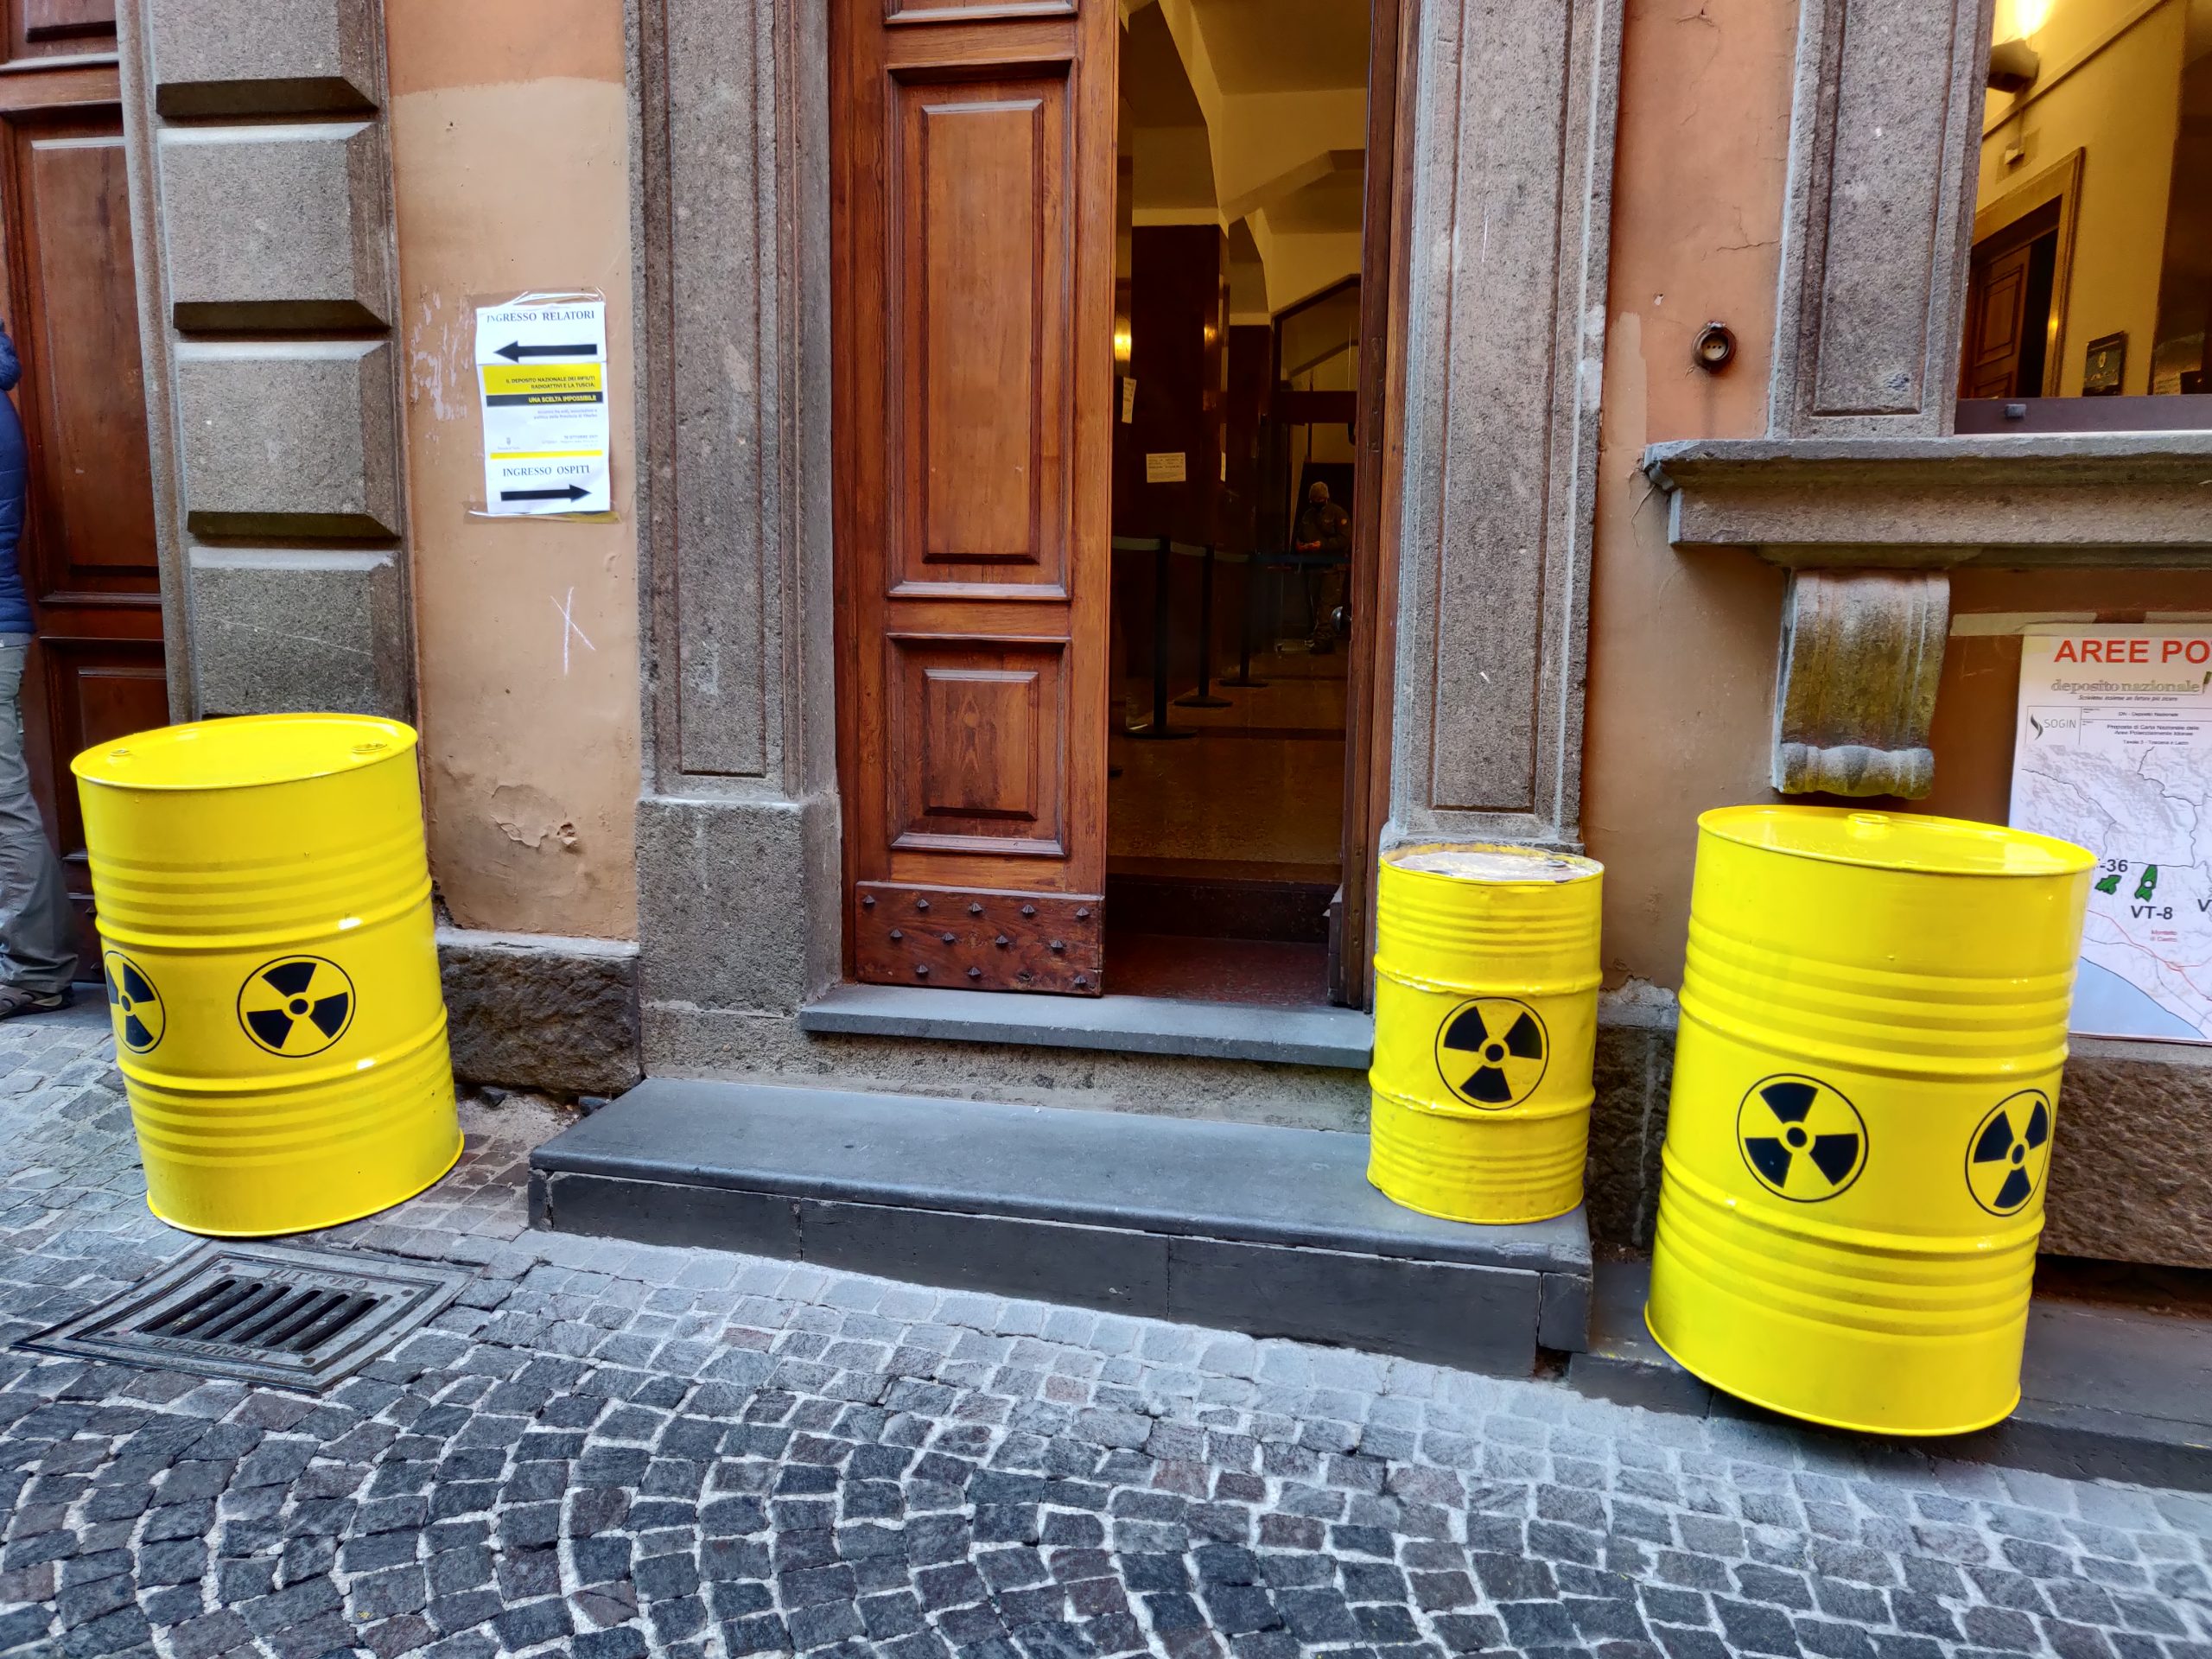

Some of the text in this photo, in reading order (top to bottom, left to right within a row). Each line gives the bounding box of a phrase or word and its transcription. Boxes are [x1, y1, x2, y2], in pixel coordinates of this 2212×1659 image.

[486, 310, 595, 323] INGRESSO RELATORI
[502, 465, 590, 477] INGRESSO OSPITI
[2054, 639, 2212, 664] AREE PO
[2044, 719, 2076, 728] SOGIN
[2097, 859, 2128, 873] -36
[2197, 899, 2212, 912] V
[2131, 905, 2173, 920] VT-8
